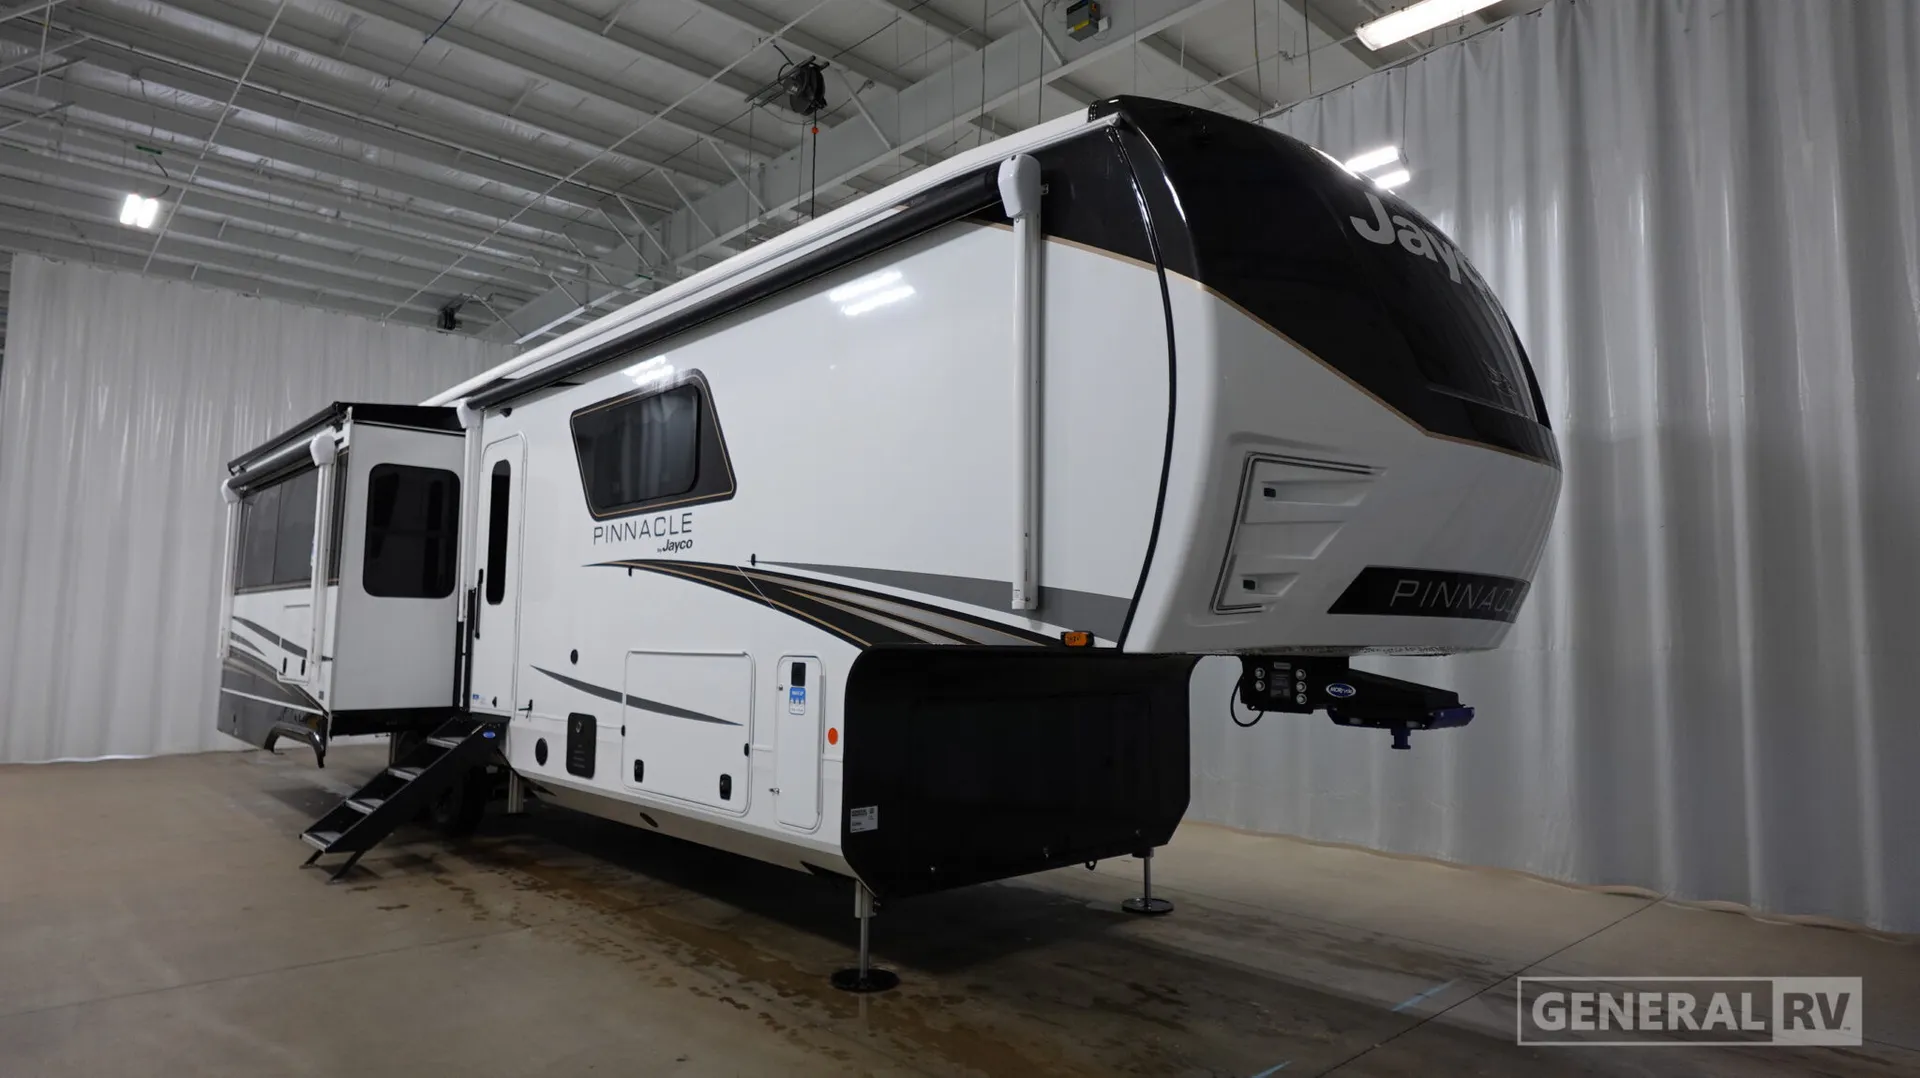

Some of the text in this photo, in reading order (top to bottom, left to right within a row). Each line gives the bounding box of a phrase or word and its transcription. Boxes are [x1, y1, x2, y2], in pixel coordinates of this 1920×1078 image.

[1350, 191, 1492, 302] Jayc
[593, 512, 692, 545] PINNACLE
[662, 539, 693, 553] Jayco
[1390, 579, 1517, 613] PINNAC
